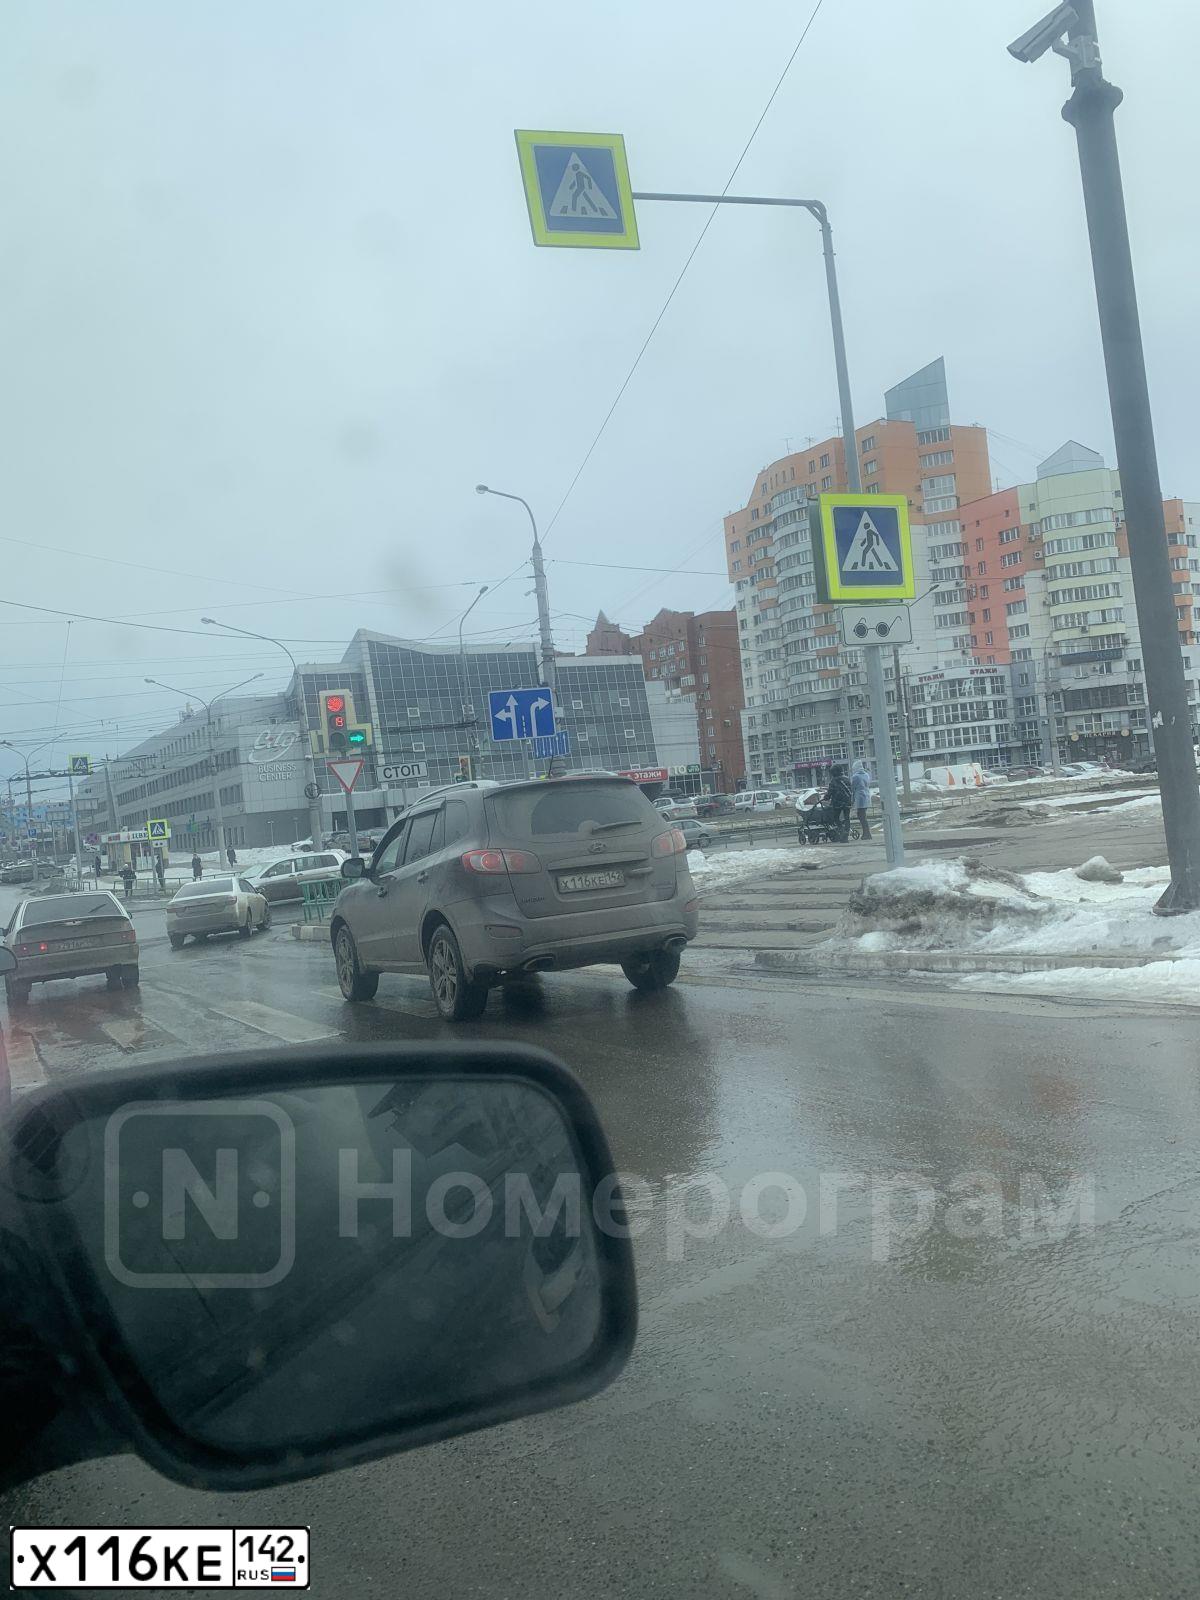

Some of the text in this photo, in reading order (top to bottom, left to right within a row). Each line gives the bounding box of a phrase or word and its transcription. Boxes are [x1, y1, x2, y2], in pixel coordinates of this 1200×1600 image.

[258, 762, 297, 774] BUSINESS
[383, 764, 421, 779] СТОП
[259, 771, 292, 782] CENTER
